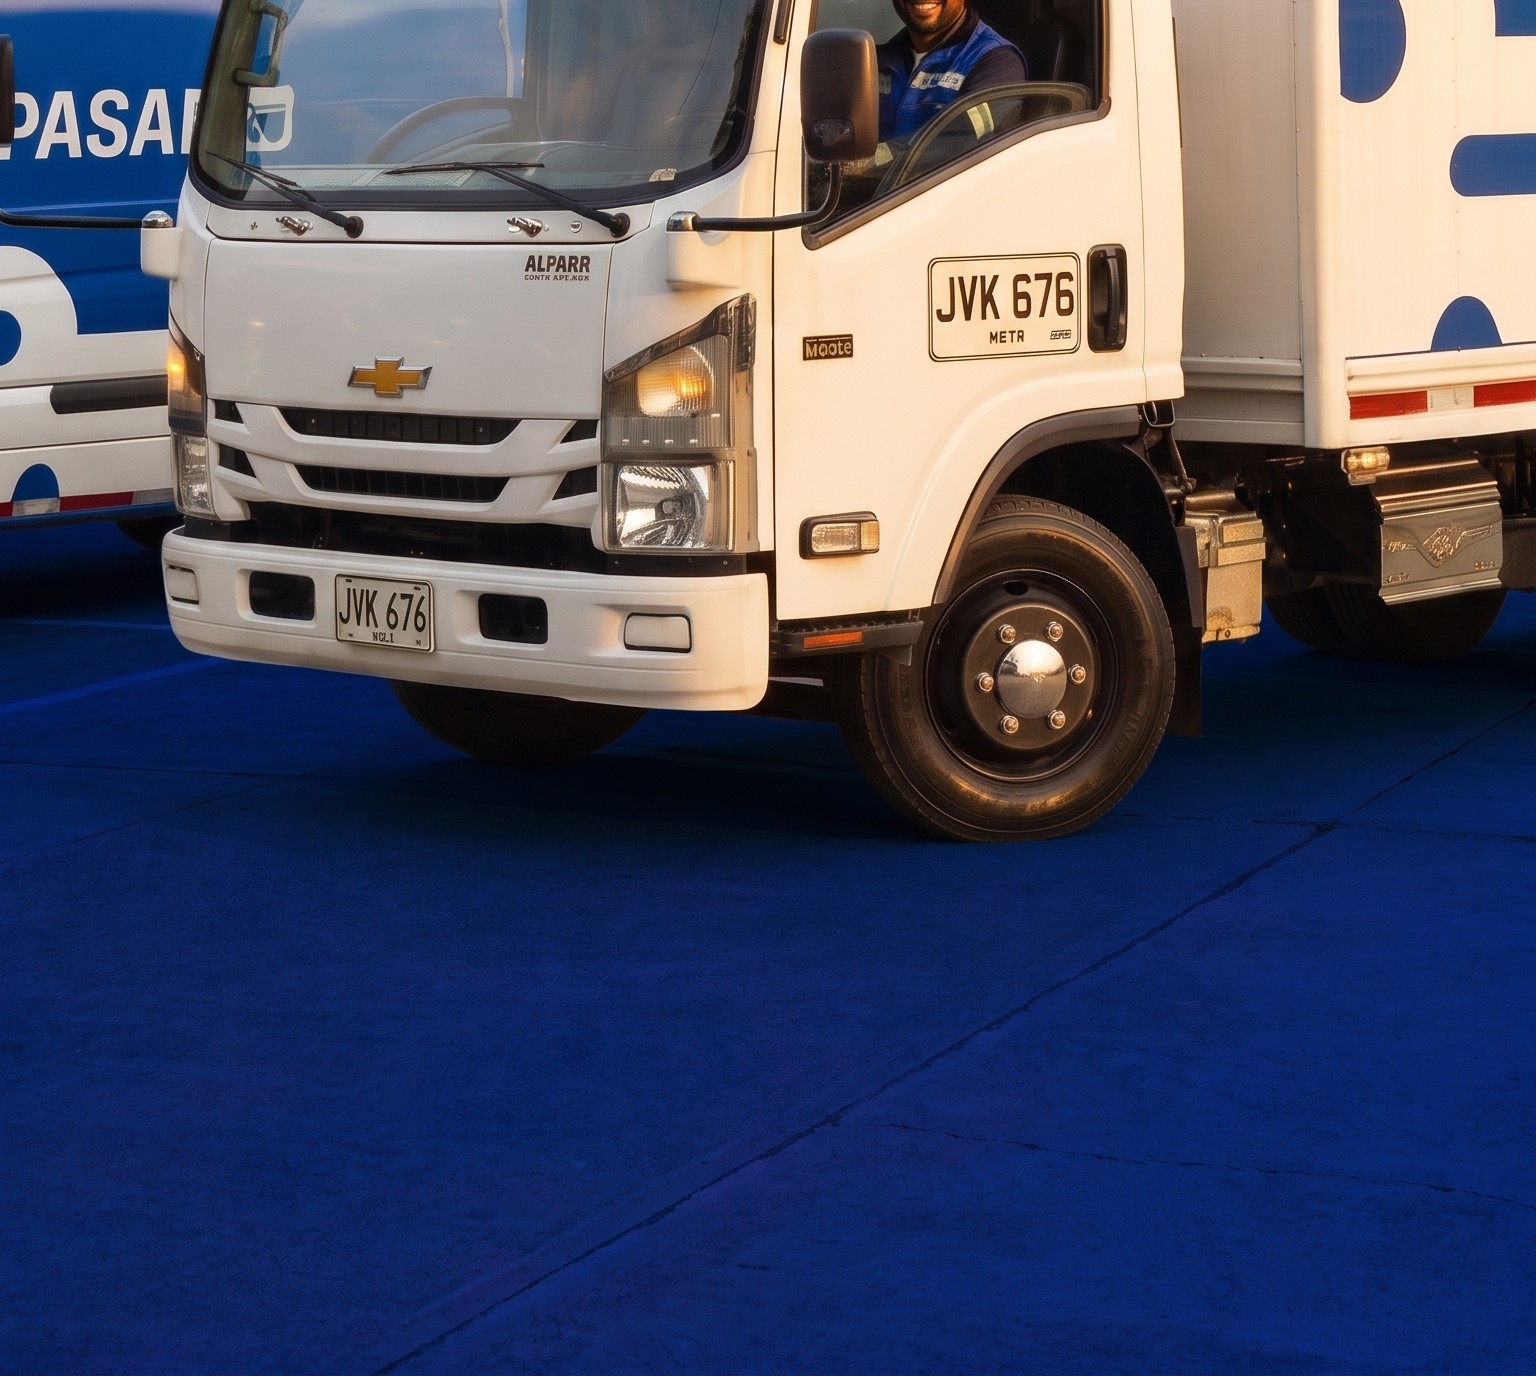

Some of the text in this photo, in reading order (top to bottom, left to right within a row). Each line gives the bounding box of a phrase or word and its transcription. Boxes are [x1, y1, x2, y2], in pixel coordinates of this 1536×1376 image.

[525, 255, 591, 273] ALPARR
[936, 271, 1074, 323] JVK 676
[989, 330, 1024, 344] METR
[339, 587, 426, 633] JVK 676
